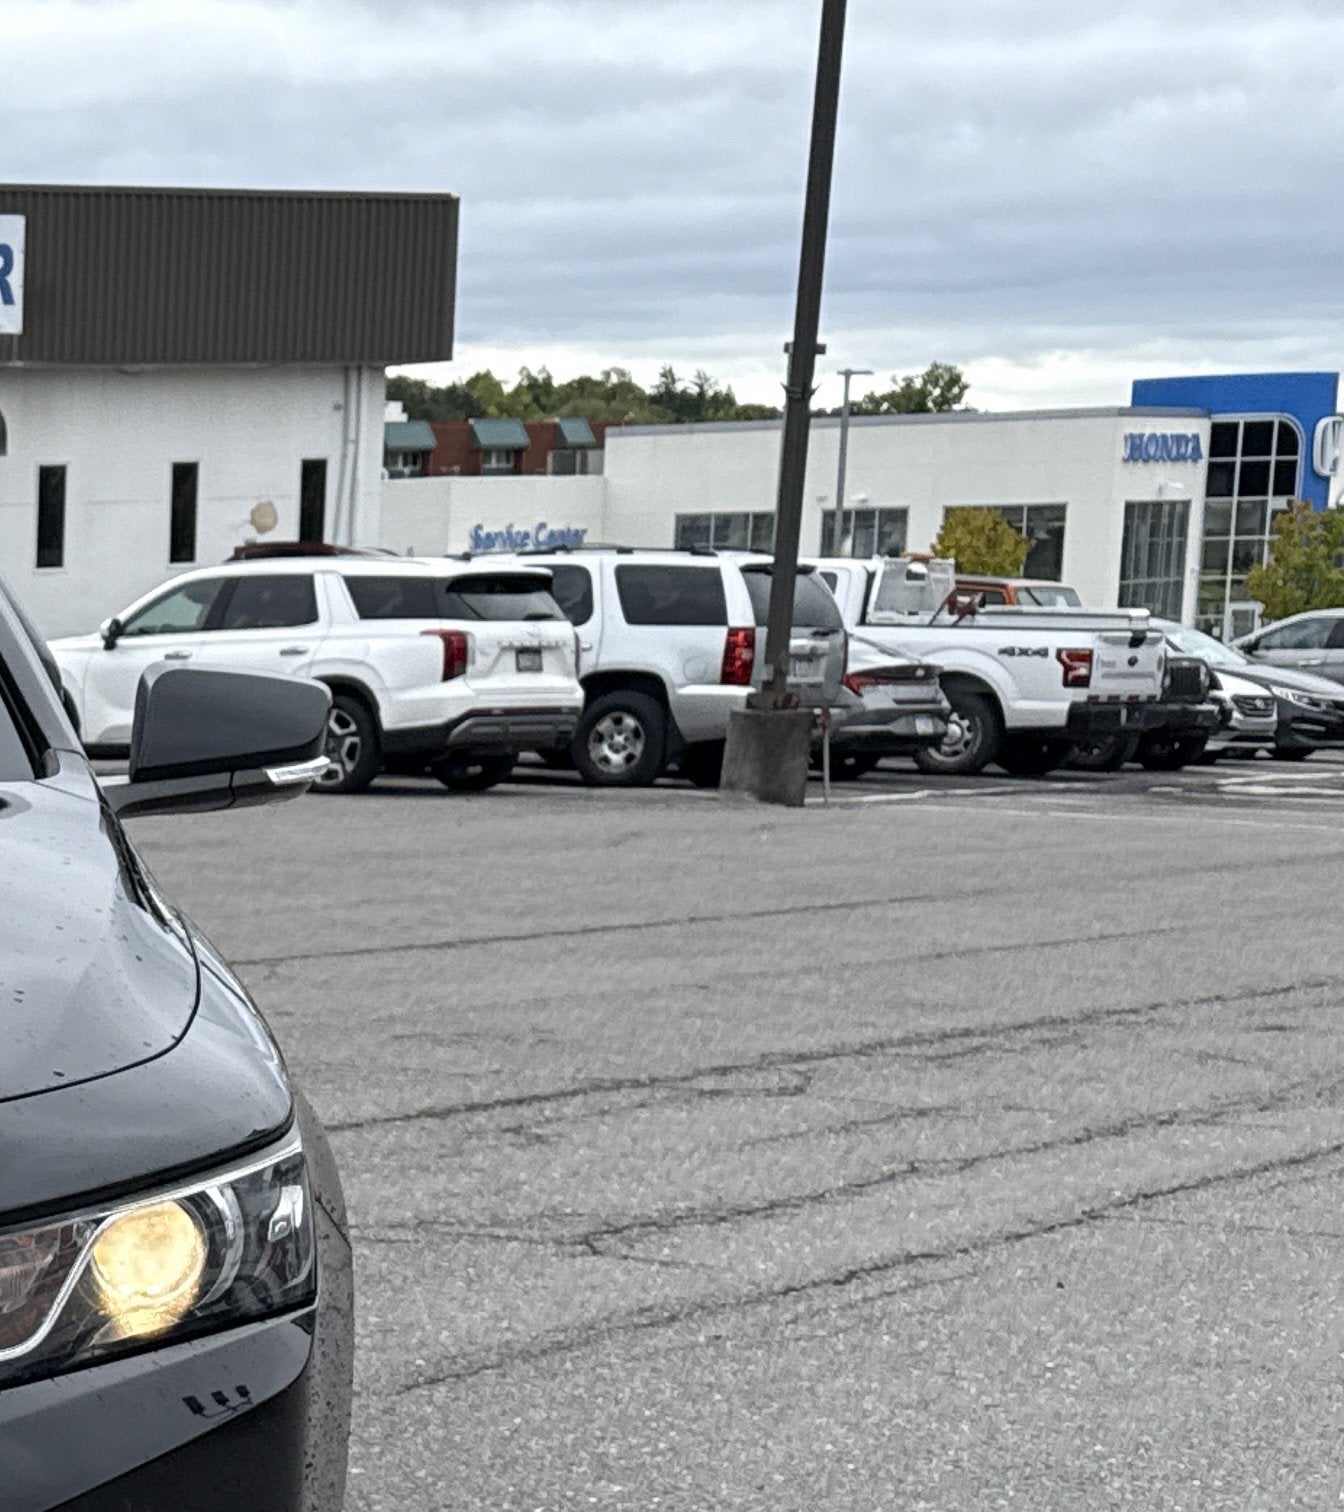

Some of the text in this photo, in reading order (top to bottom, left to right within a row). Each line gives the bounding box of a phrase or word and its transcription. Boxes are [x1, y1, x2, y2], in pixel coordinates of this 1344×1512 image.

[1123, 431, 1204, 464] HONDA
[469, 521, 588, 551] Service Center
